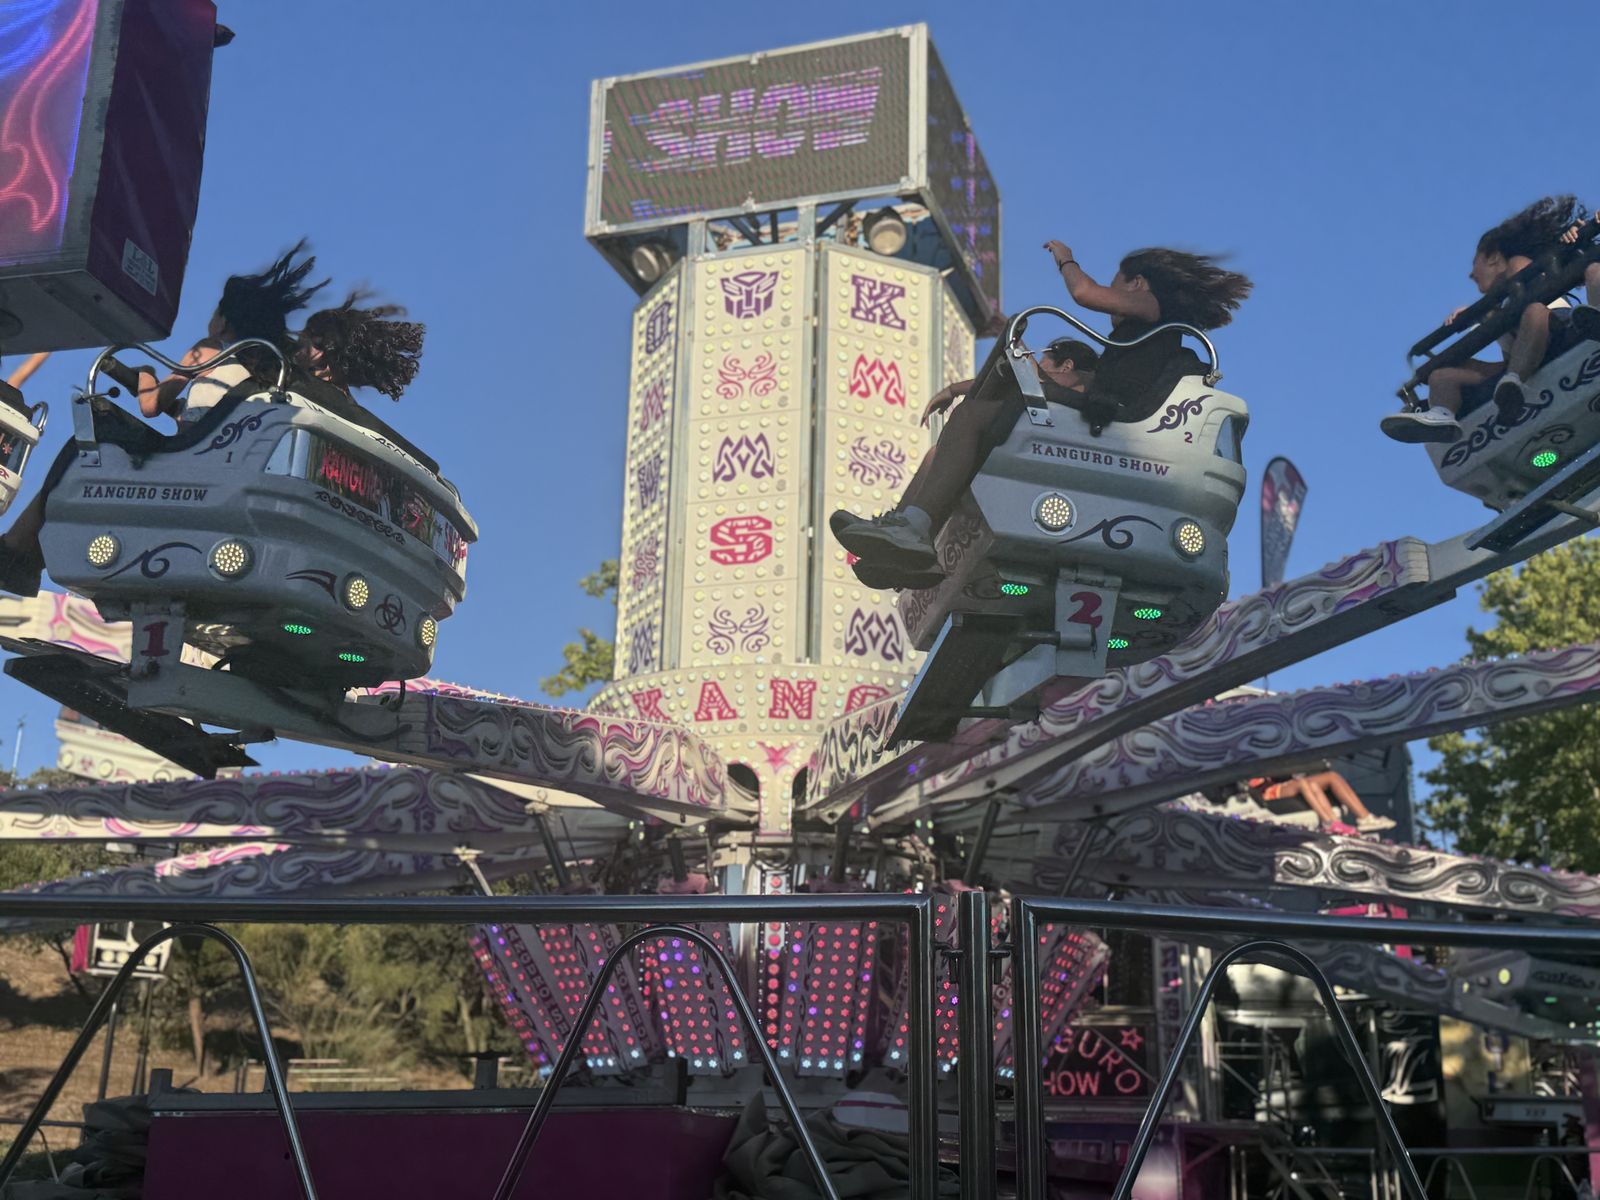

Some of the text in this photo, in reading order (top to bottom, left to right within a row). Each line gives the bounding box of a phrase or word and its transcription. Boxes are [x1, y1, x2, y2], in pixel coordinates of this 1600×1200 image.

[640, 67, 883, 173] SHOW
[851, 275, 906, 331] K
[1184, 432, 1193, 444] 2
[1032, 443, 1171, 477] KANGURO SHOW
[83, 485, 208, 502] KANGURO SHOW
[709, 515, 774, 565] S
[1067, 591, 1103, 628] 2
[140, 621, 170, 657] 1
